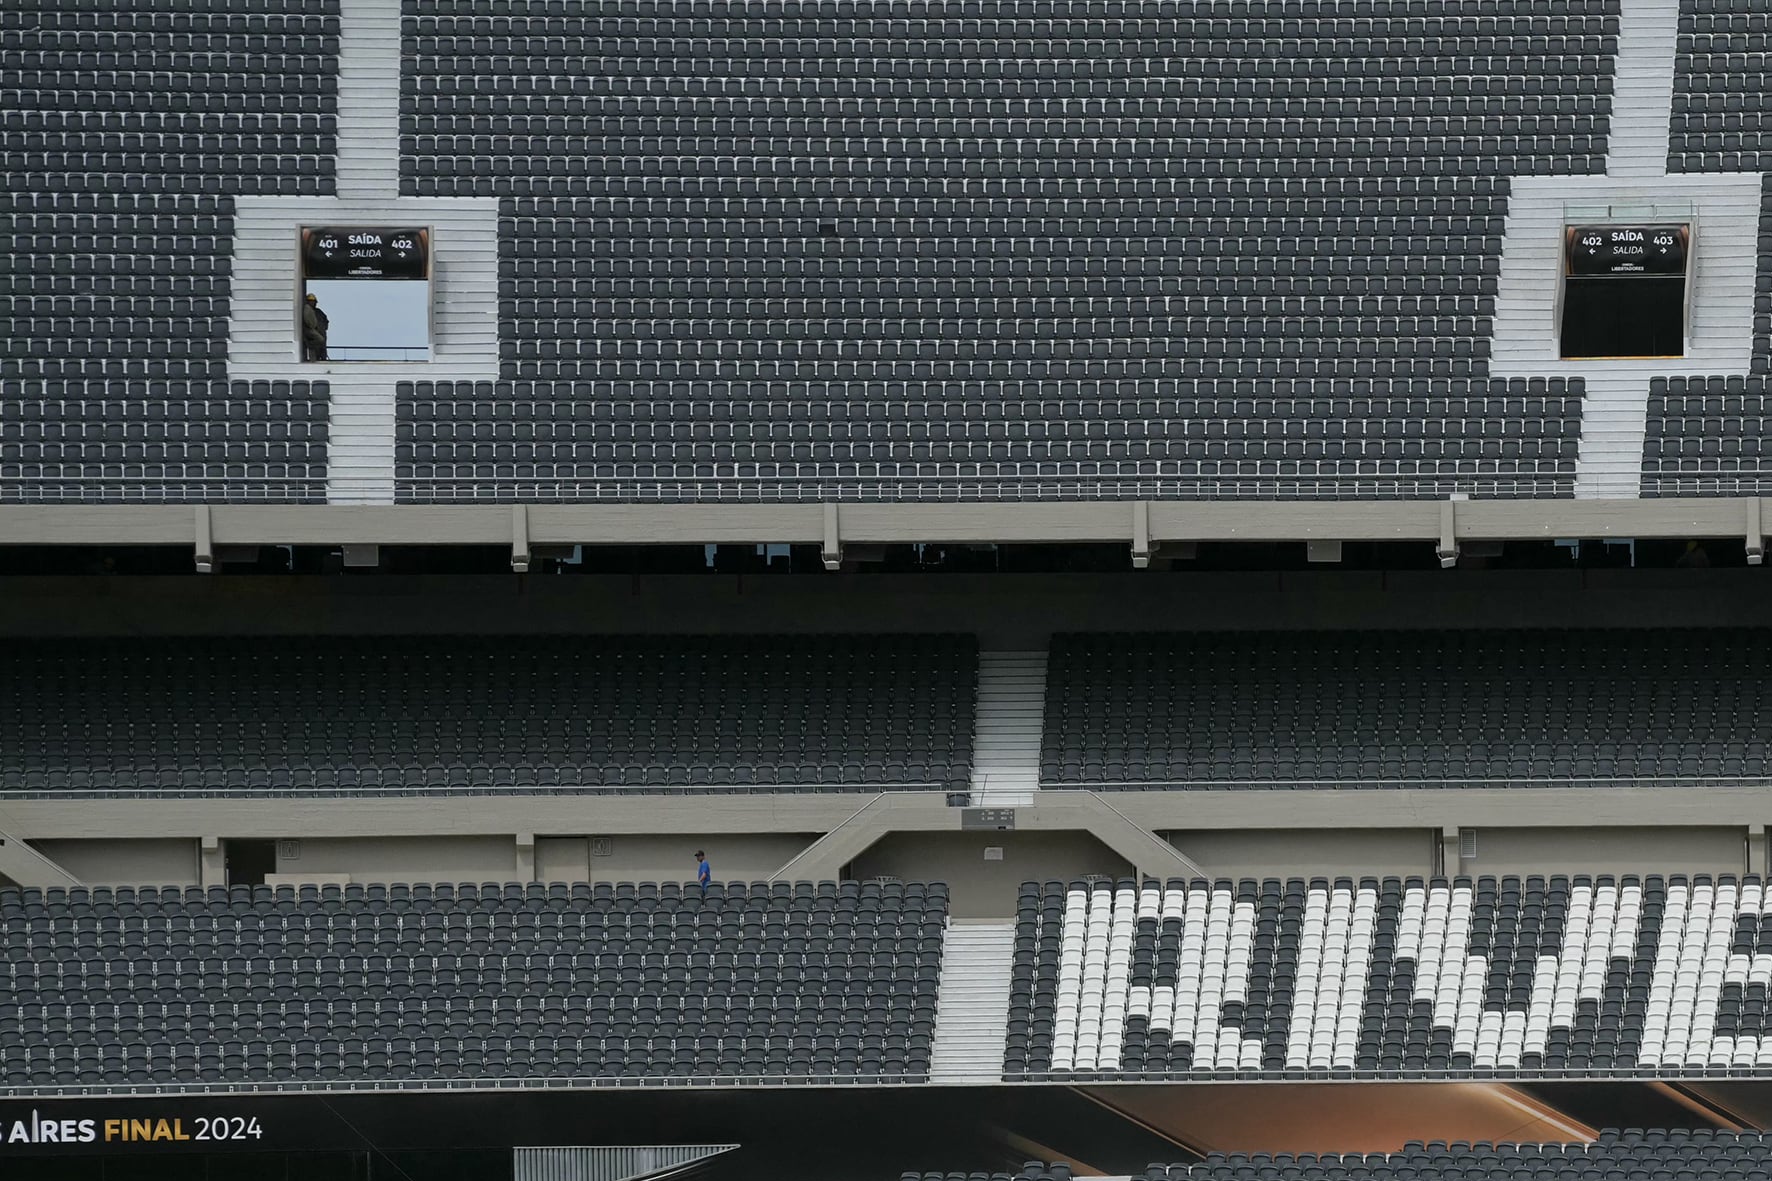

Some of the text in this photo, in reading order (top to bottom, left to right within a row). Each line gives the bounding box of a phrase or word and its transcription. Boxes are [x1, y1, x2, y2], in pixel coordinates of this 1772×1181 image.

[348, 232, 382, 245] SAÍDA
[1611, 230, 1644, 241] SAÍDA
[319, 240, 338, 248] 401
[391, 240, 413, 249] 402
[1582, 237, 1602, 246] 402
[1653, 236, 1673, 245] 403
[350, 249, 382, 258] SALIDA
[1613, 246, 1643, 254] SALIDA
[8, 1108, 96, 1143] AIRES
[104, 1118, 190, 1142] FINAL
[194, 1116, 262, 1140] 2024
